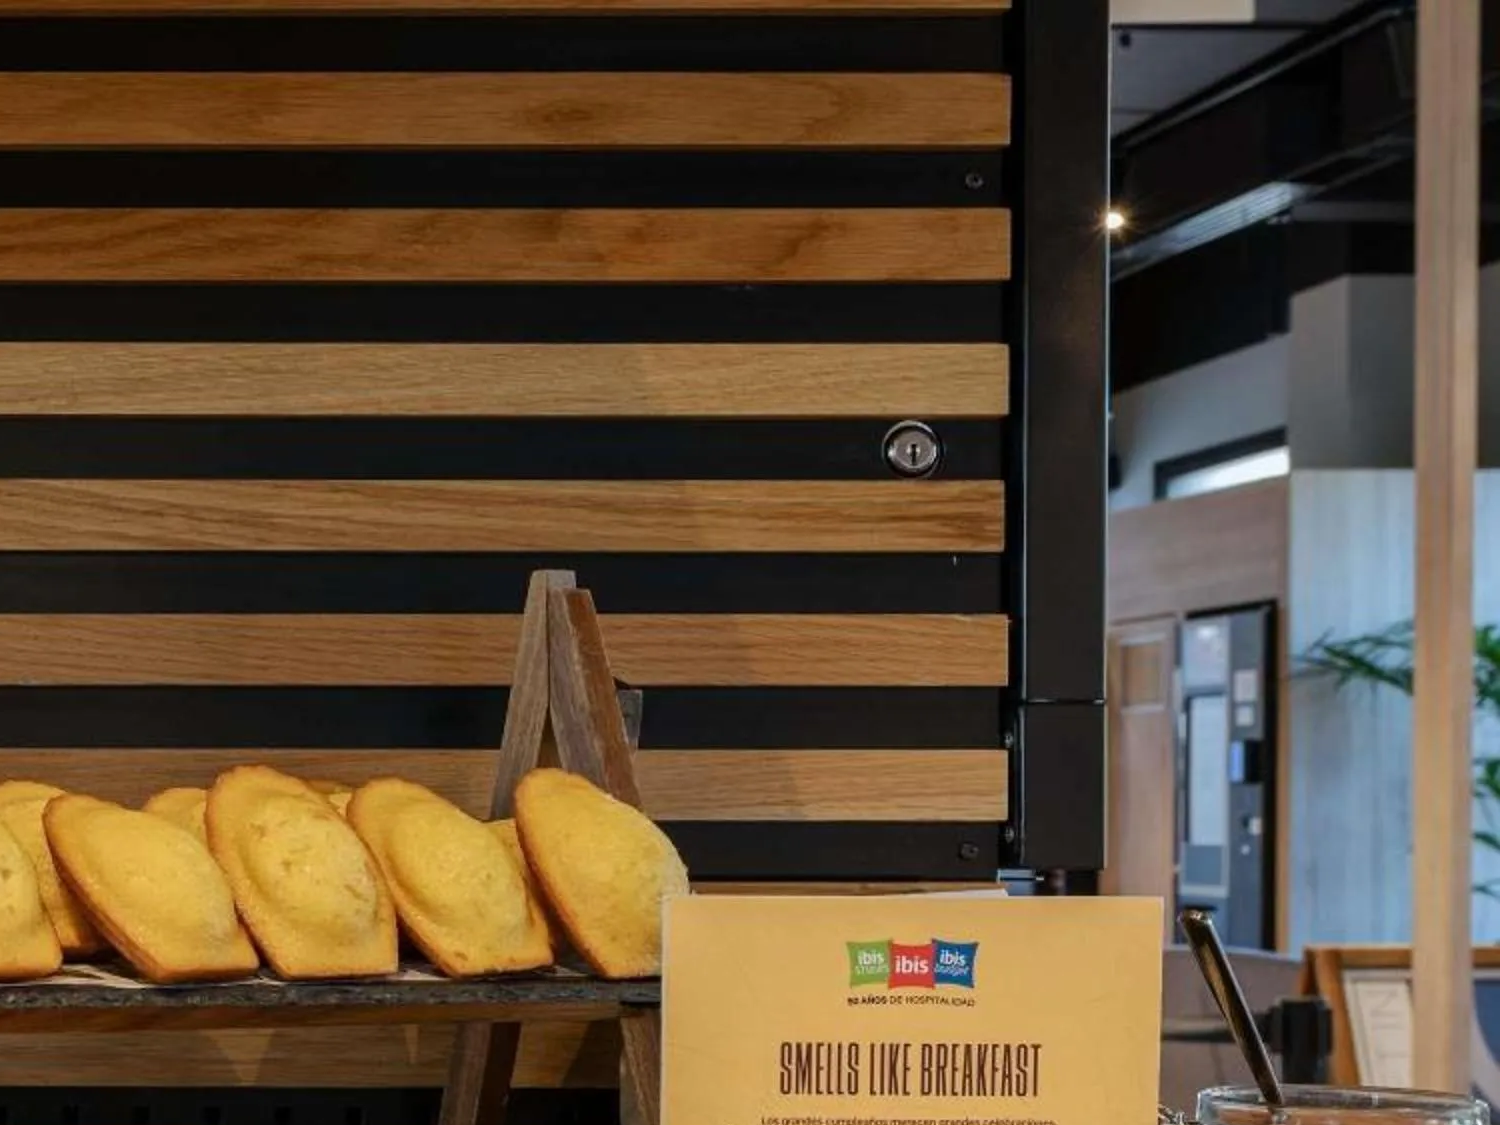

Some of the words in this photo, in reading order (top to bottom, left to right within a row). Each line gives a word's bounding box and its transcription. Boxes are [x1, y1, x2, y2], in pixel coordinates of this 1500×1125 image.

[858, 950, 884, 965] ibis
[895, 955, 929, 974] ibis
[940, 949, 966, 967] ibis
[890, 996, 902, 1005] DE
[780, 1042, 860, 1096] SMELLS
[869, 1043, 911, 1097] LIKE
[920, 1043, 1042, 1098] BREAKFAST
